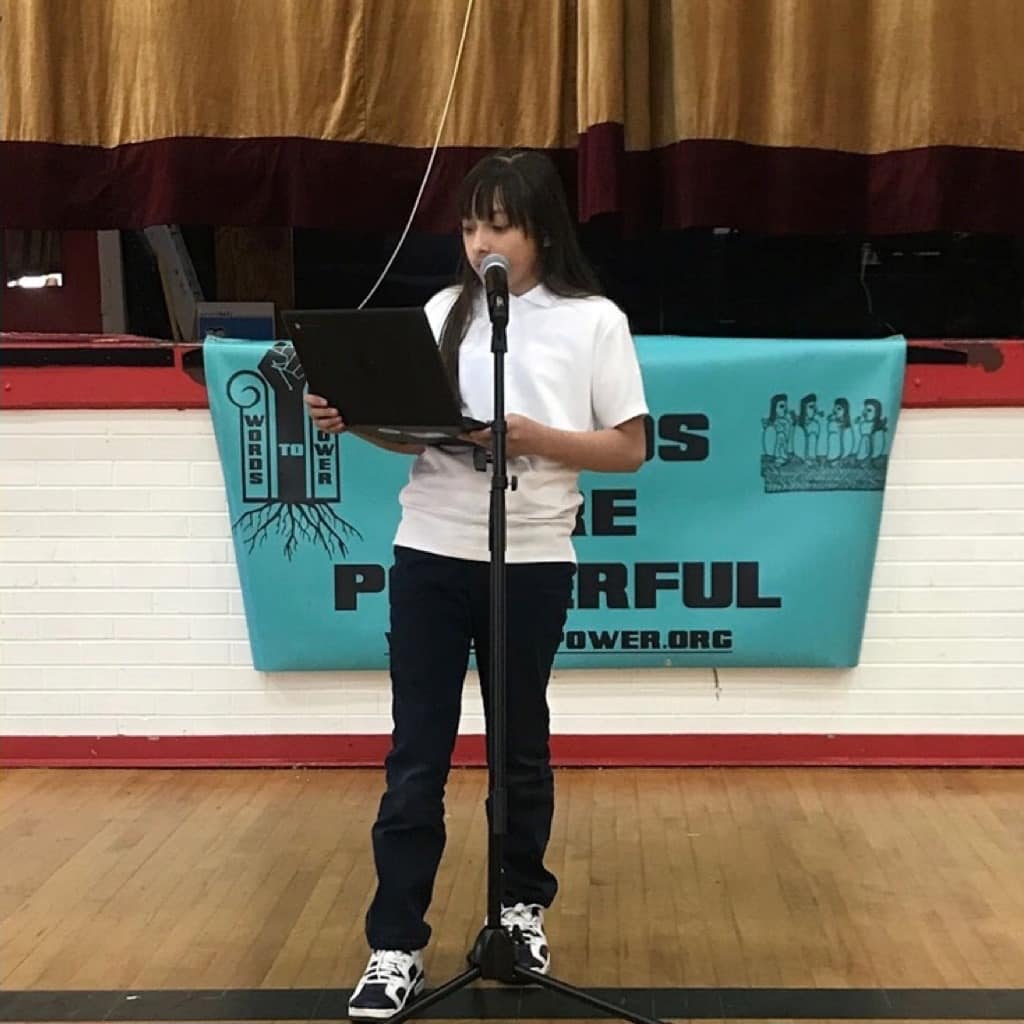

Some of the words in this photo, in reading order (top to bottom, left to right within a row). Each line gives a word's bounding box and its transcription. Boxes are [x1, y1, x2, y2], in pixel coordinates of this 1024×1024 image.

[244, 414, 264, 485] WORDS
[278, 443, 304, 456] TO
[314, 428, 334, 485] OWER
